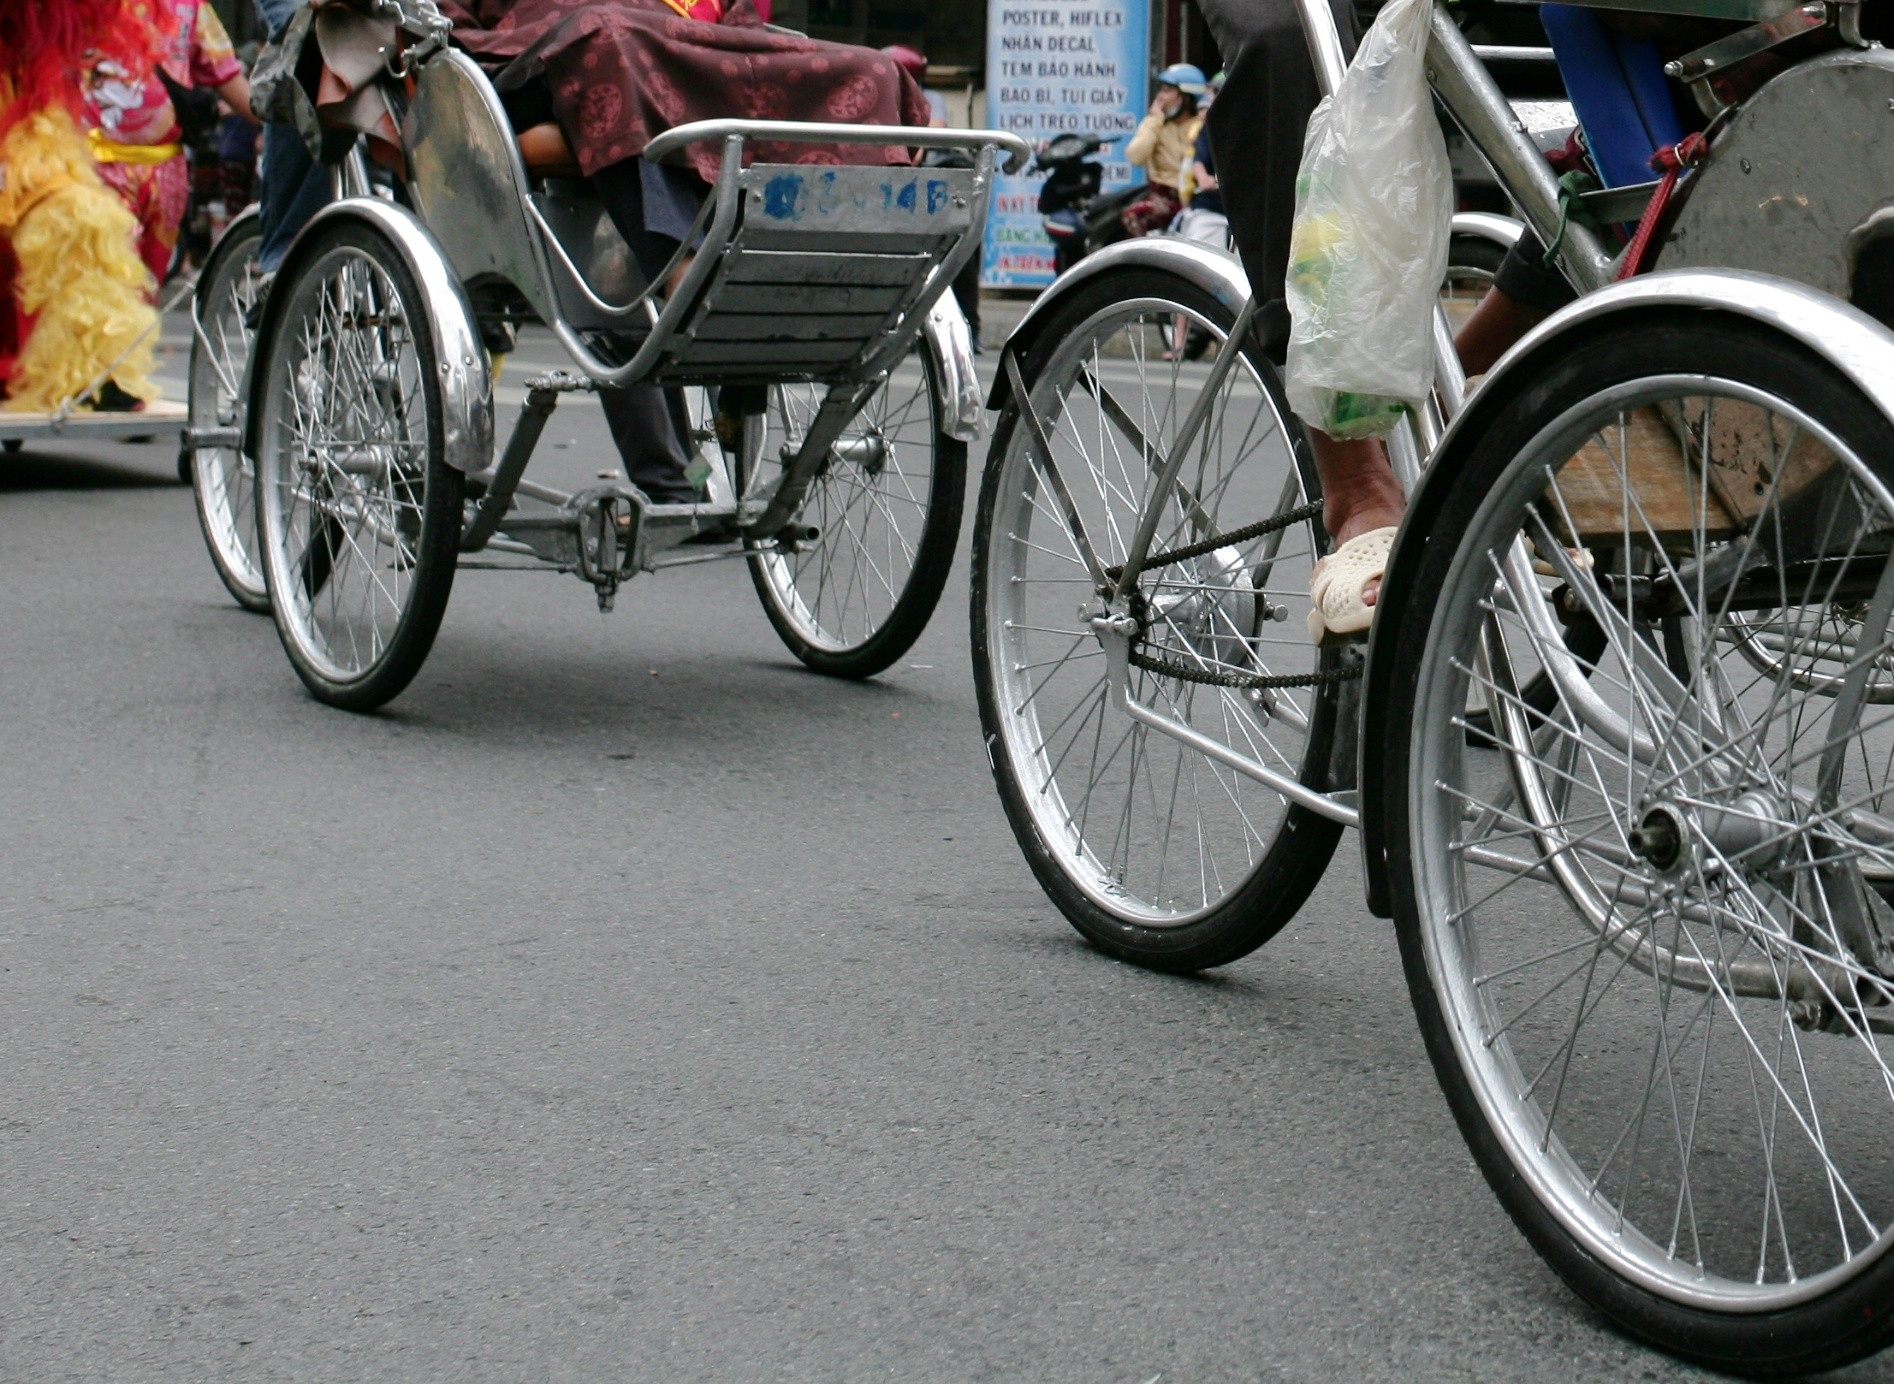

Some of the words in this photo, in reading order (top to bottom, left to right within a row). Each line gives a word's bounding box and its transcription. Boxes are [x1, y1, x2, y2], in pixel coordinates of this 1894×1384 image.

[1069, 10, 1123, 27] HIFLEX
[1048, 35, 1095, 52] DECAL
[1002, 61, 1033, 77] TEM
